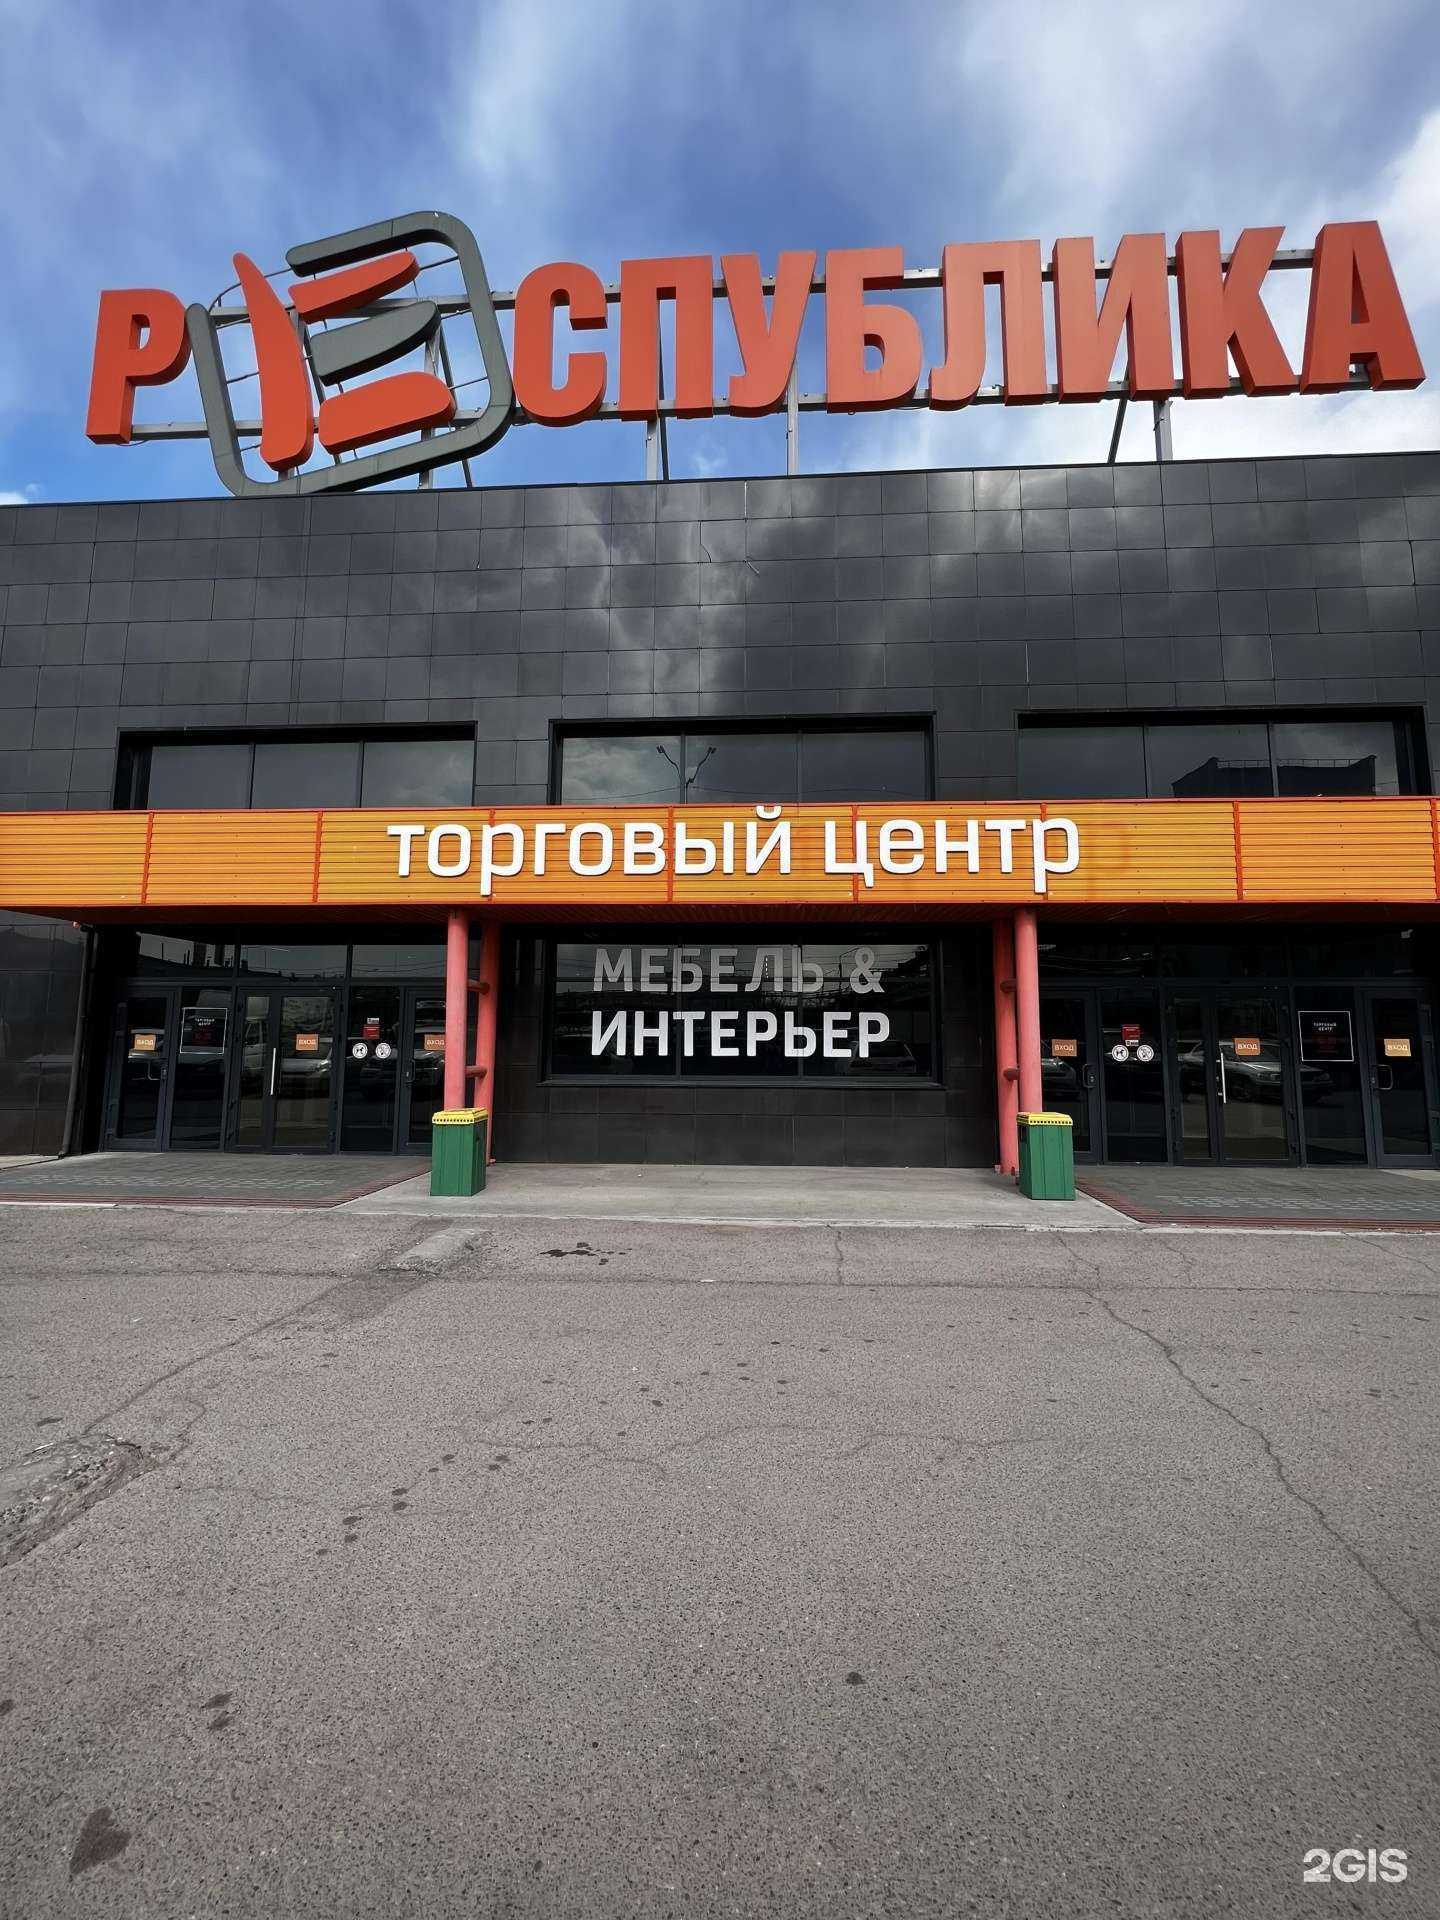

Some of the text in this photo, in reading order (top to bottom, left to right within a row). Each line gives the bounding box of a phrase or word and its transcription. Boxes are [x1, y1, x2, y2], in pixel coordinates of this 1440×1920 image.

[387, 805, 1080, 895] торговый центр
[592, 946, 885, 994] МЕБЕЛЬ &
[590, 1010, 891, 1058] ИНТЕРЬЕР
[1054, 1044, 1075, 1052] ВХОД
[1237, 1042, 1258, 1051] ВХОД
[1387, 1044, 1408, 1052] ВХОД
